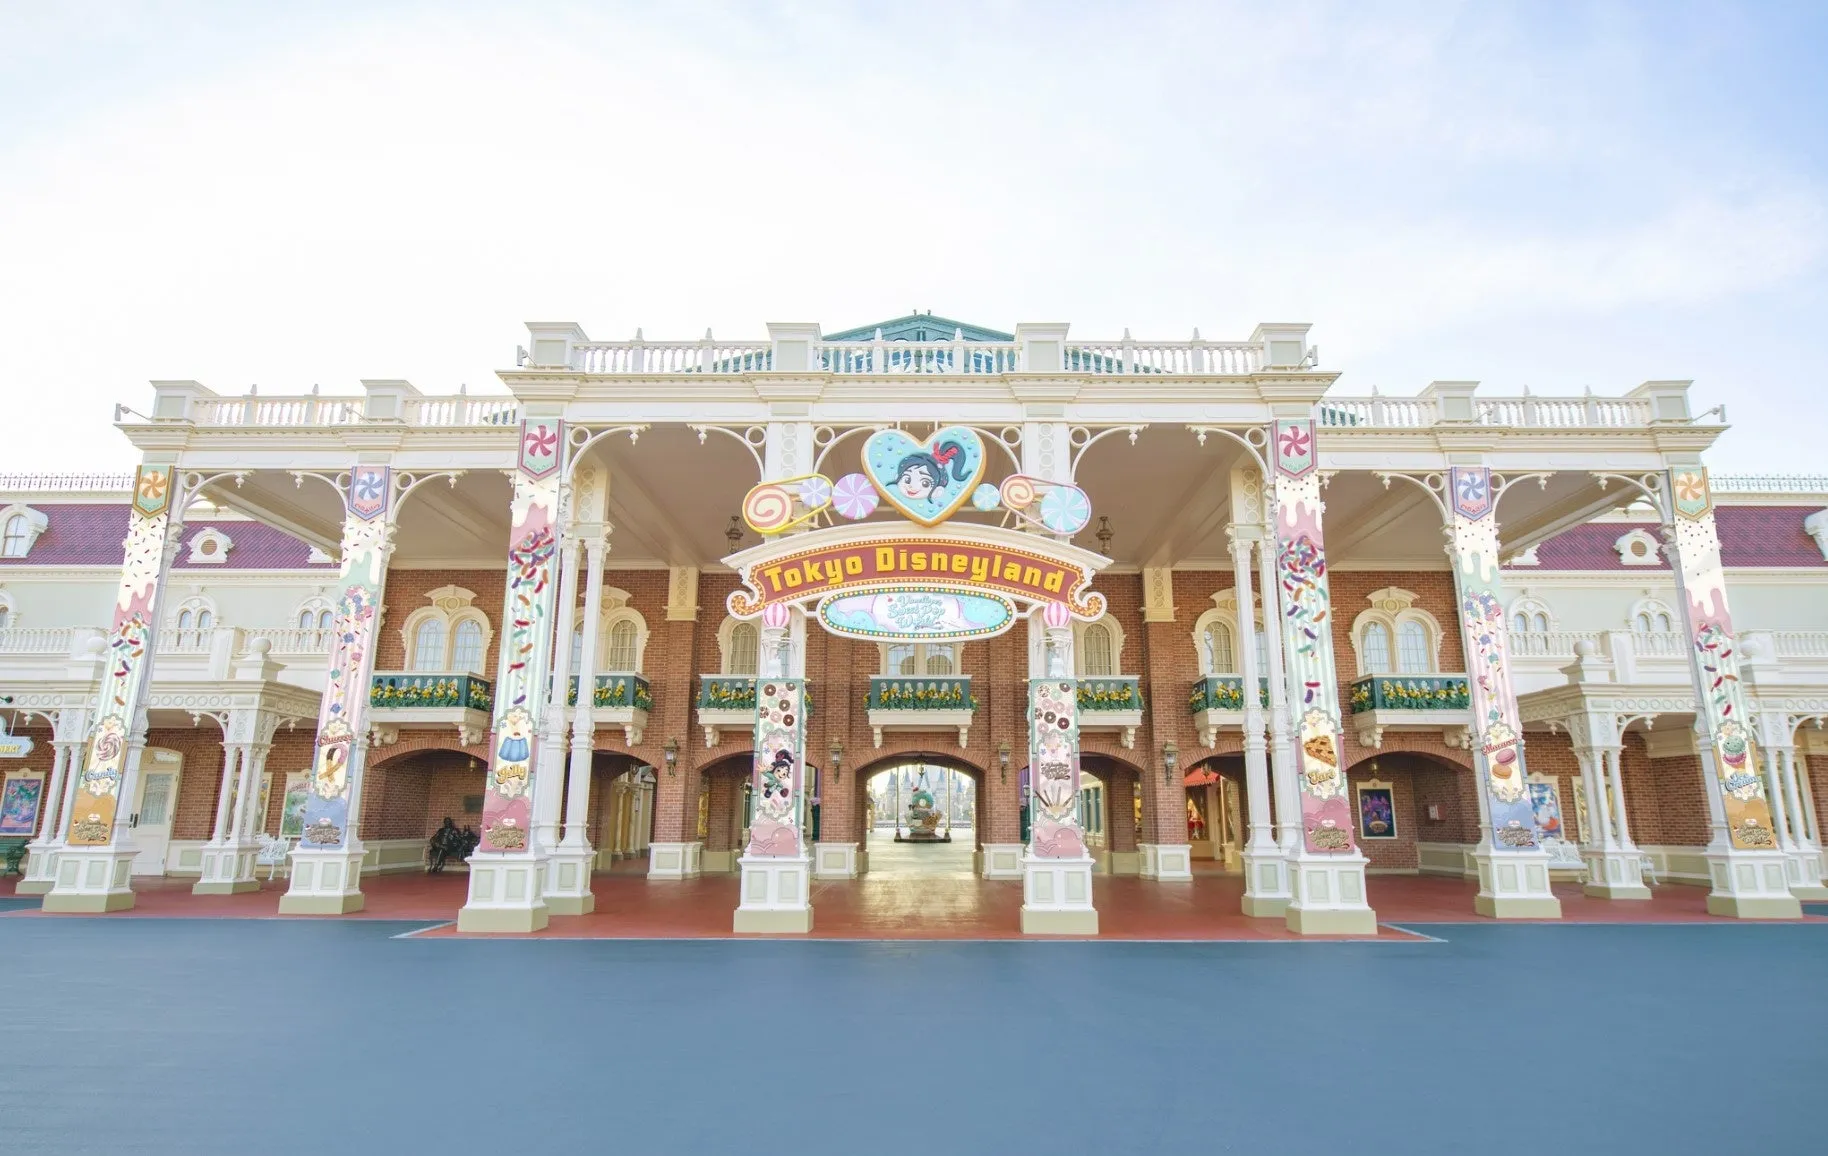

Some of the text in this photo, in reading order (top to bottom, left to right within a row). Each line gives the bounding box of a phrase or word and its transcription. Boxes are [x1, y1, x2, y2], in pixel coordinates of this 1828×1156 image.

[764, 547, 1066, 594] Tokyo Disneyland
[85, 767, 117, 782] Candy
